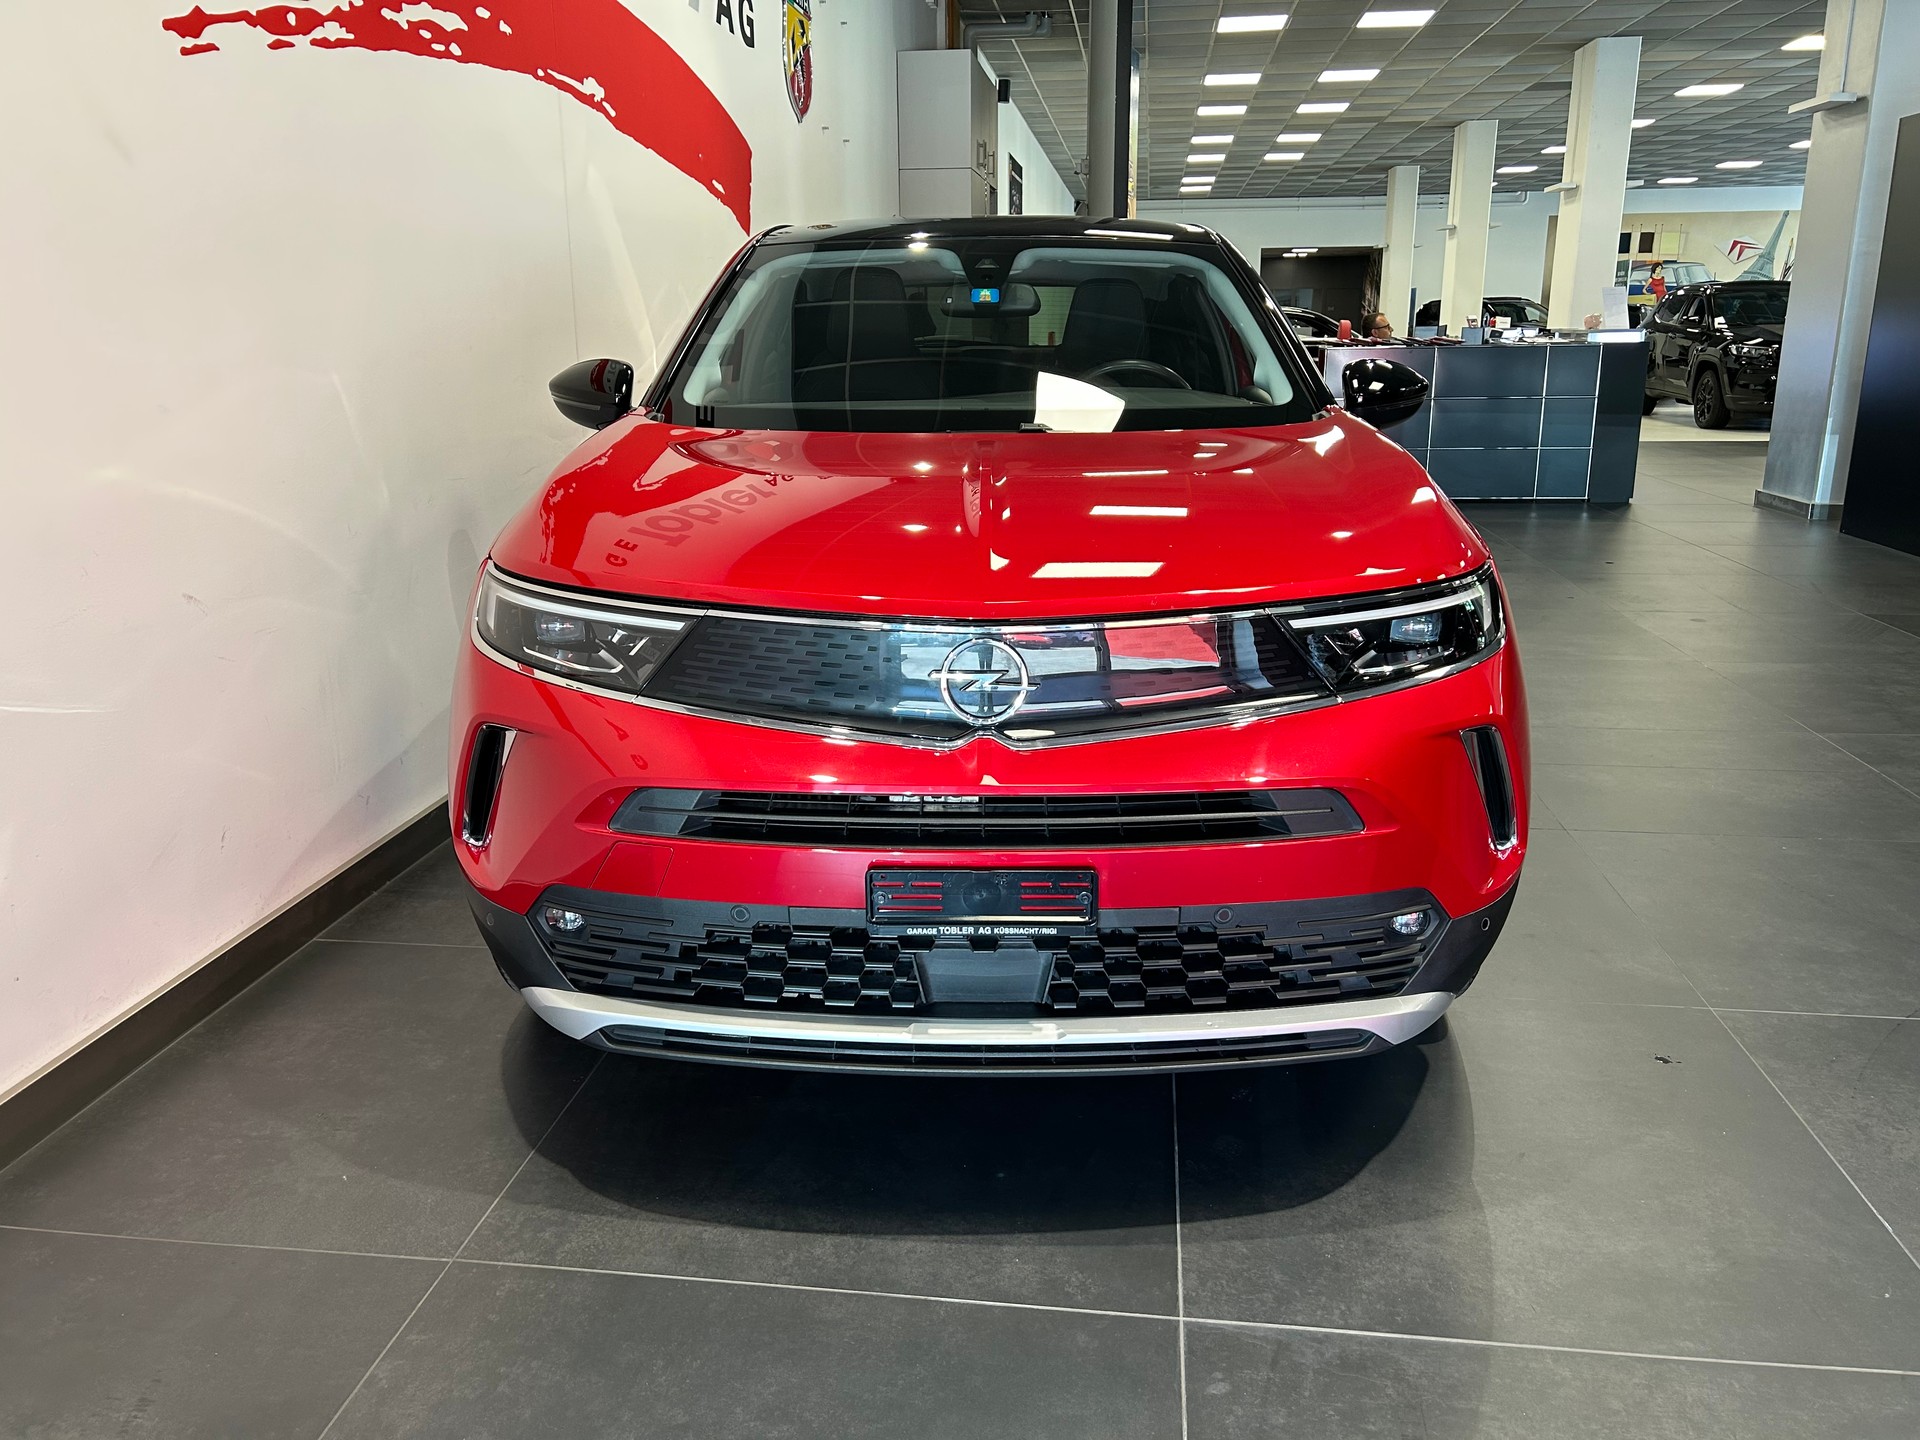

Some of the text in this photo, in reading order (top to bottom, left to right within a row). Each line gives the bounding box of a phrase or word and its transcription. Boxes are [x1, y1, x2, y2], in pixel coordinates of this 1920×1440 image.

[715, 0, 756, 49] AG
[906, 927, 938, 935] GARAGE
[938, 926, 975, 935] TOBLER
[977, 926, 992, 935] AG
